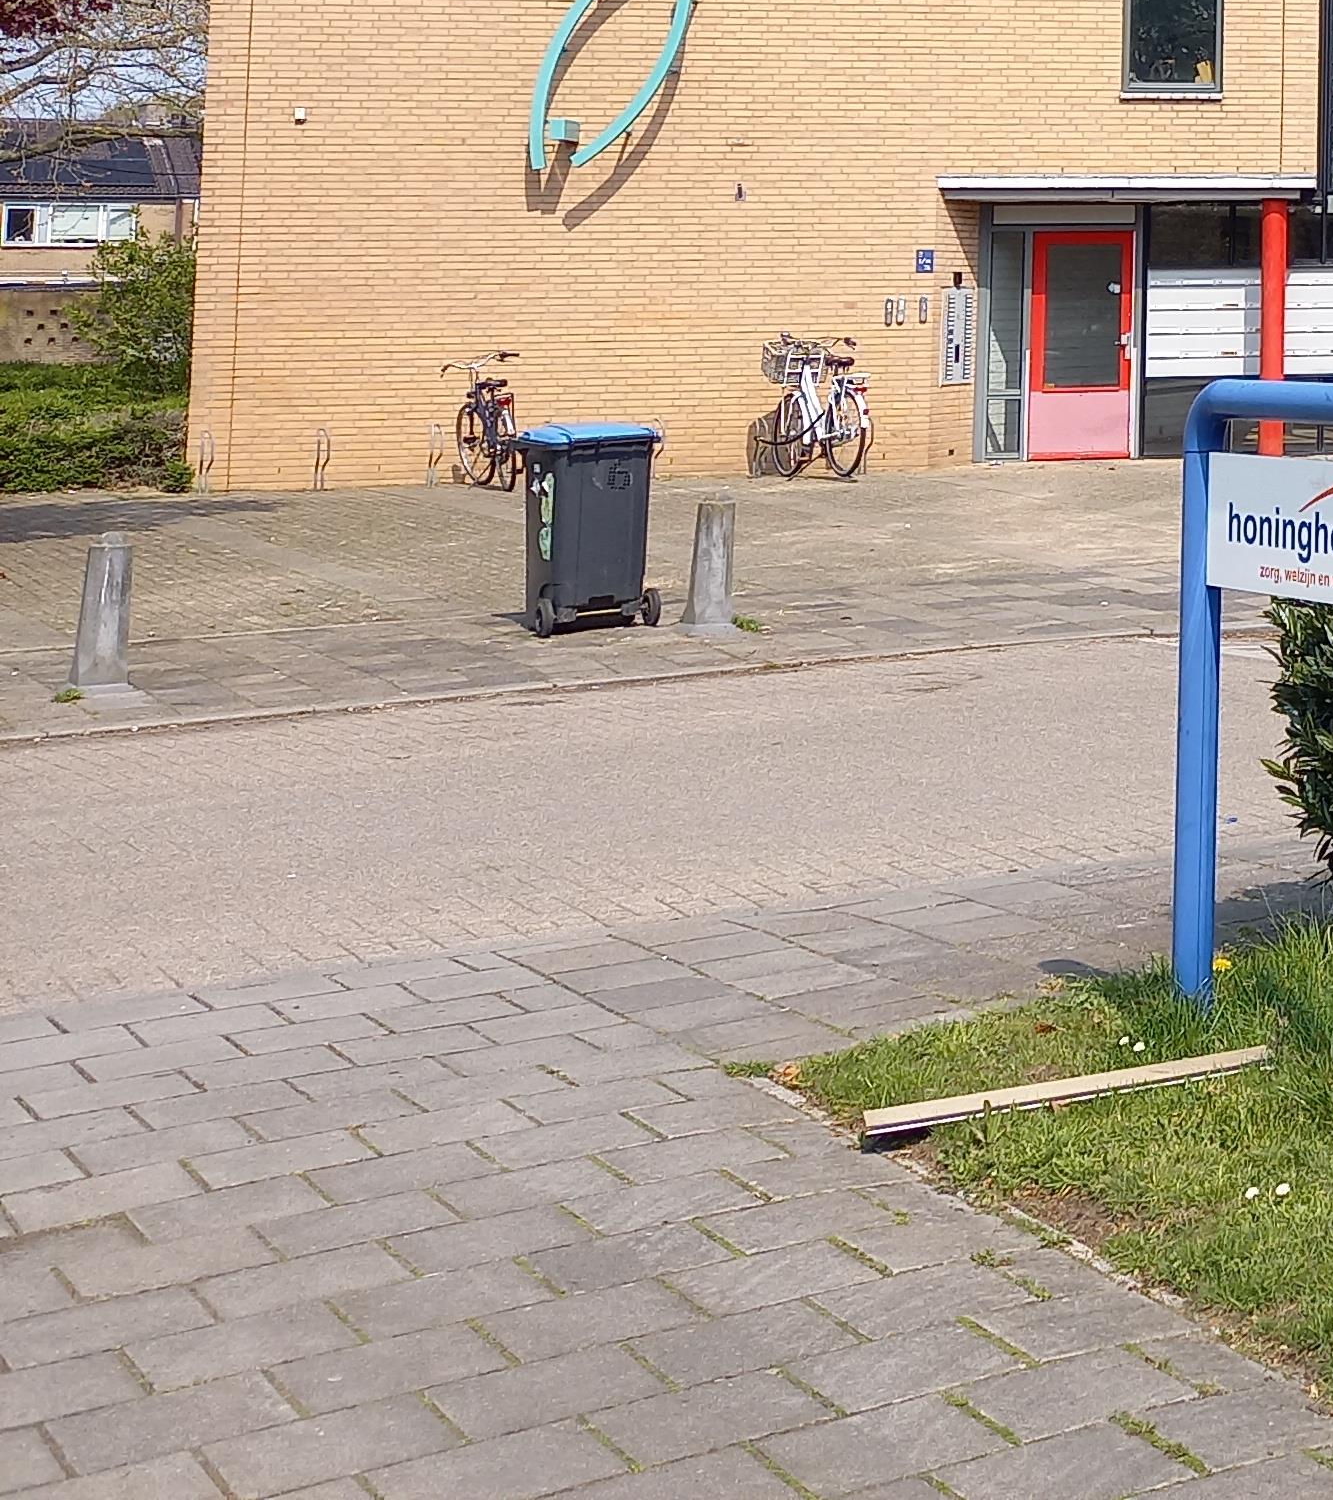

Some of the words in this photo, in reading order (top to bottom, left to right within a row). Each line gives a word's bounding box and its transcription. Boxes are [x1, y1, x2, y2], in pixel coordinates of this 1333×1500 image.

[1259, 566, 1282, 584] zorg,
[1284, 567, 1316, 588] welzijn
[1318, 574, 1330, 587] en
